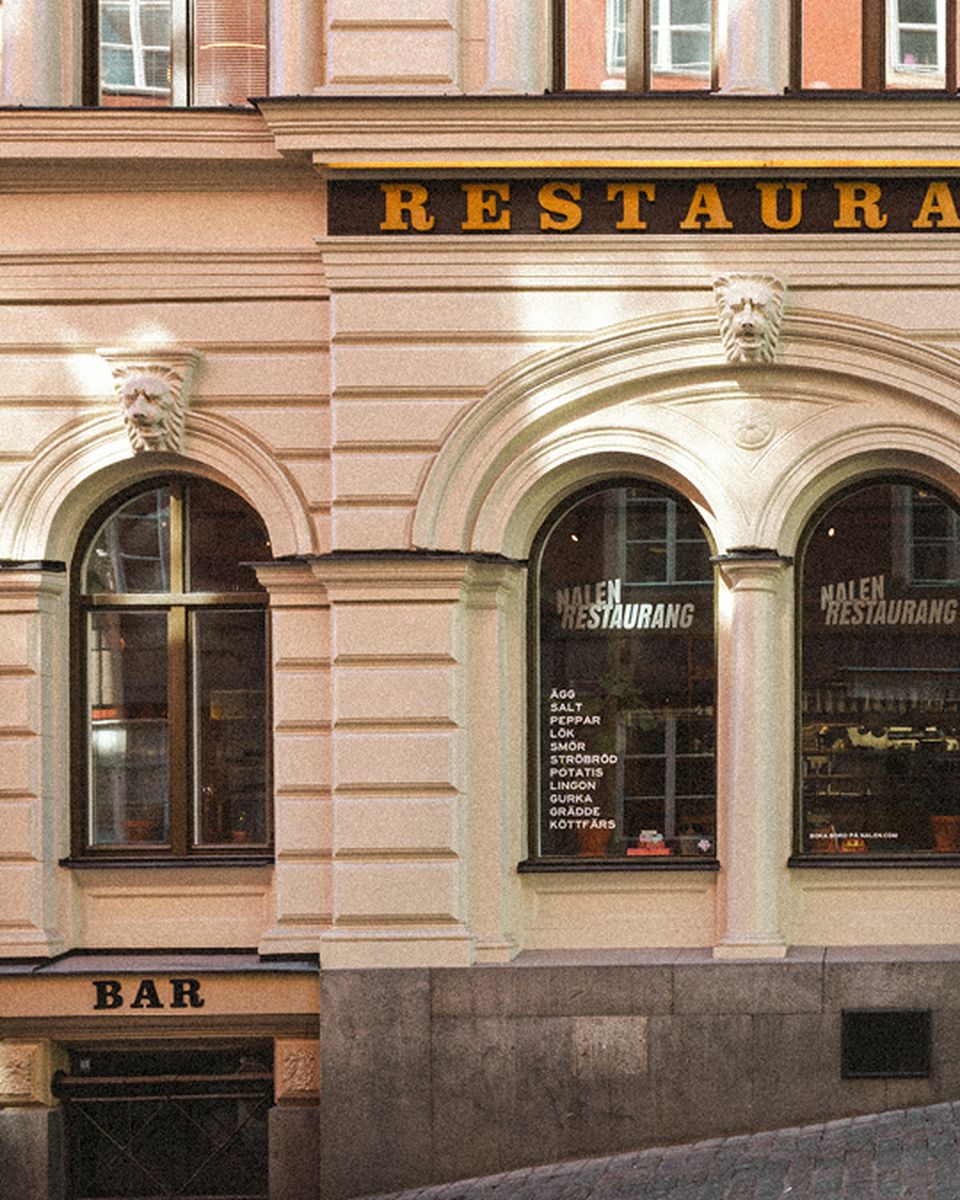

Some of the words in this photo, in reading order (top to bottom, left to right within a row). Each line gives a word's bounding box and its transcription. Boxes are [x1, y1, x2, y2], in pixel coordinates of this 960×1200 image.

[555, 578, 622, 615] NALEN
[820, 575, 885, 611] NALEN
[561, 603, 696, 630] RESTAURANG
[825, 599, 959, 626] RESTAURANG
[550, 687, 576, 700] ÄGG
[550, 702, 583, 713] SALT
[550, 715, 601, 726] PEPPAR
[550, 727, 575, 739] LÖK
[550, 741, 586, 752] SMÖR
[550, 753, 618, 765] STRÖBRÖD
[550, 767, 604, 778] POTATIS
[550, 780, 597, 791] LINGON
[550, 793, 593, 804] GURKA
[550, 805, 600, 817] GRÄDDE
[550, 818, 616, 830] KÖTTFÄRS
[92, 978, 205, 1010] BAR
